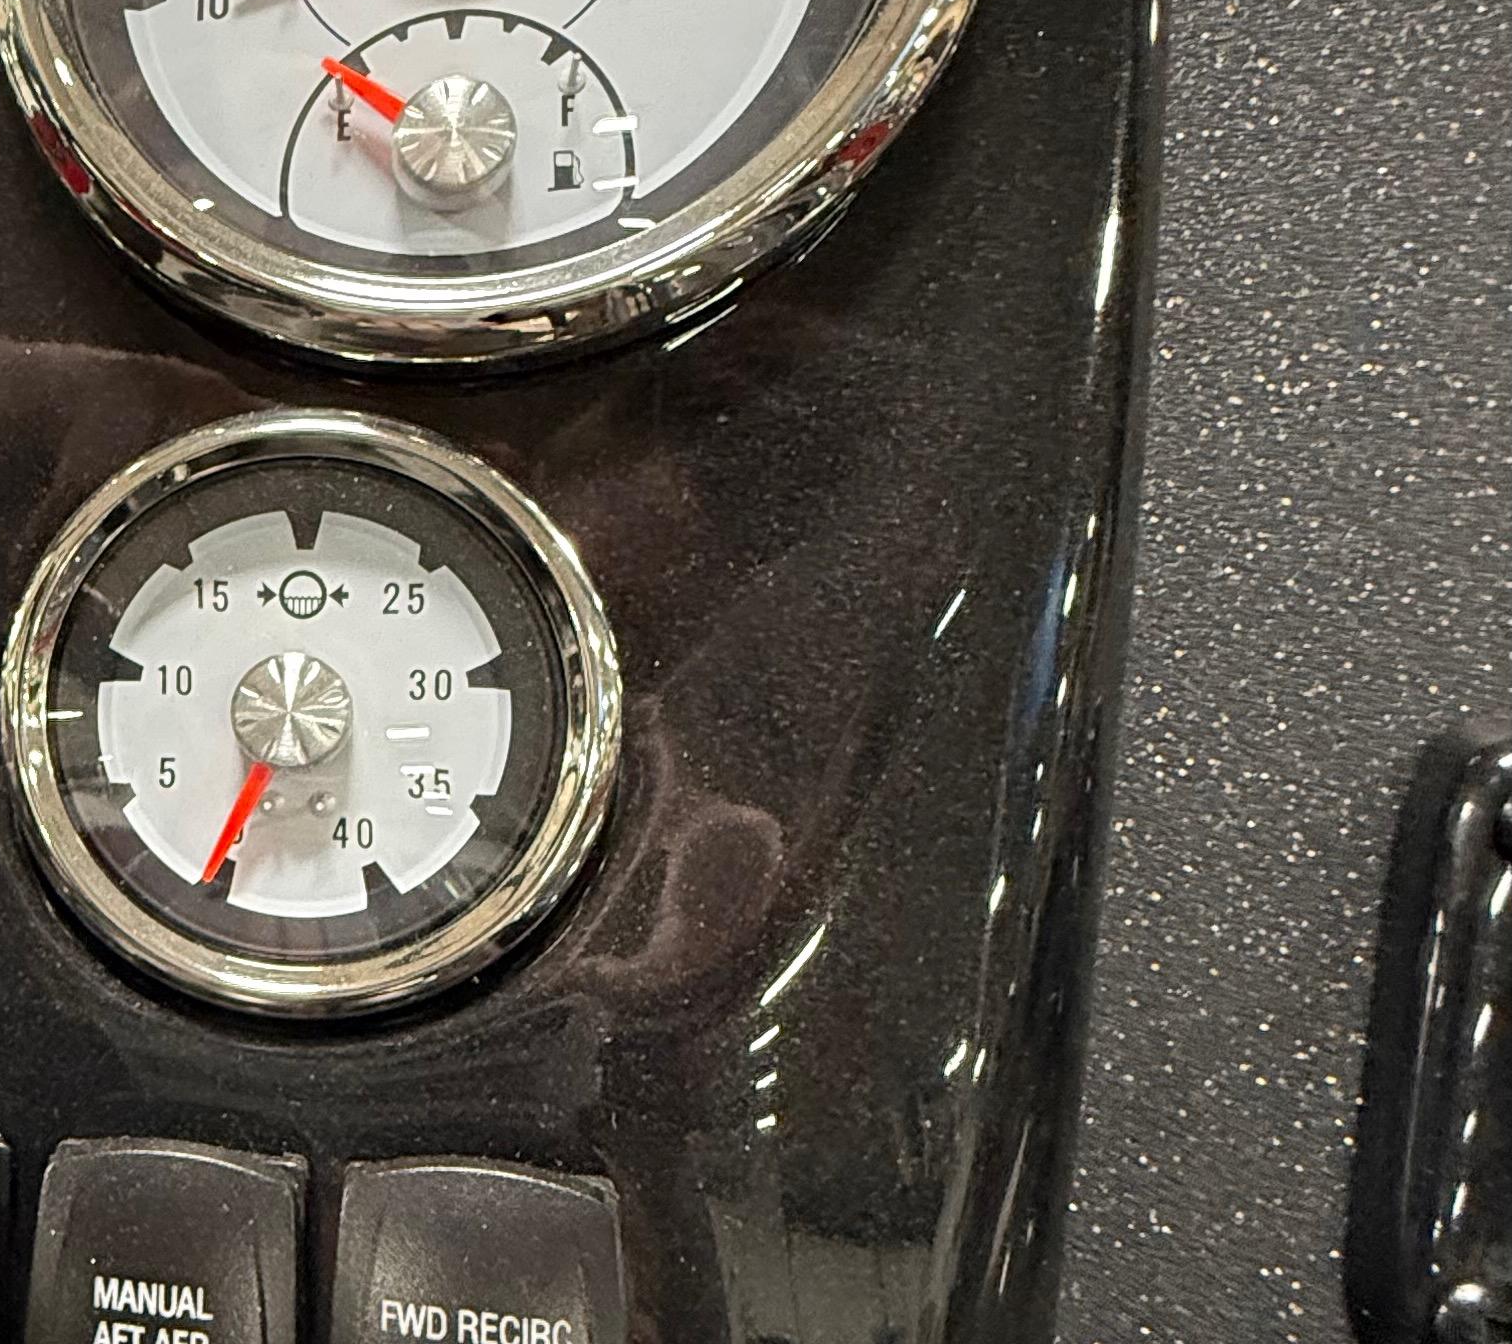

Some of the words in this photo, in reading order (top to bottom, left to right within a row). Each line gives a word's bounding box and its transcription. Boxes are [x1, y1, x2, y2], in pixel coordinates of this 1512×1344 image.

[337, 106, 353, 143] E
[560, 92, 576, 129] F
[193, 577, 229, 612] 15
[382, 582, 426, 615] 25
[158, 665, 193, 696] 10
[409, 669, 453, 701] 30
[158, 757, 176, 788] 5
[408, 768, 451, 799] 35
[332, 817, 374, 849] 40
[93, 1276, 214, 1321] MANUAL
[380, 1299, 448, 1339] FWD
